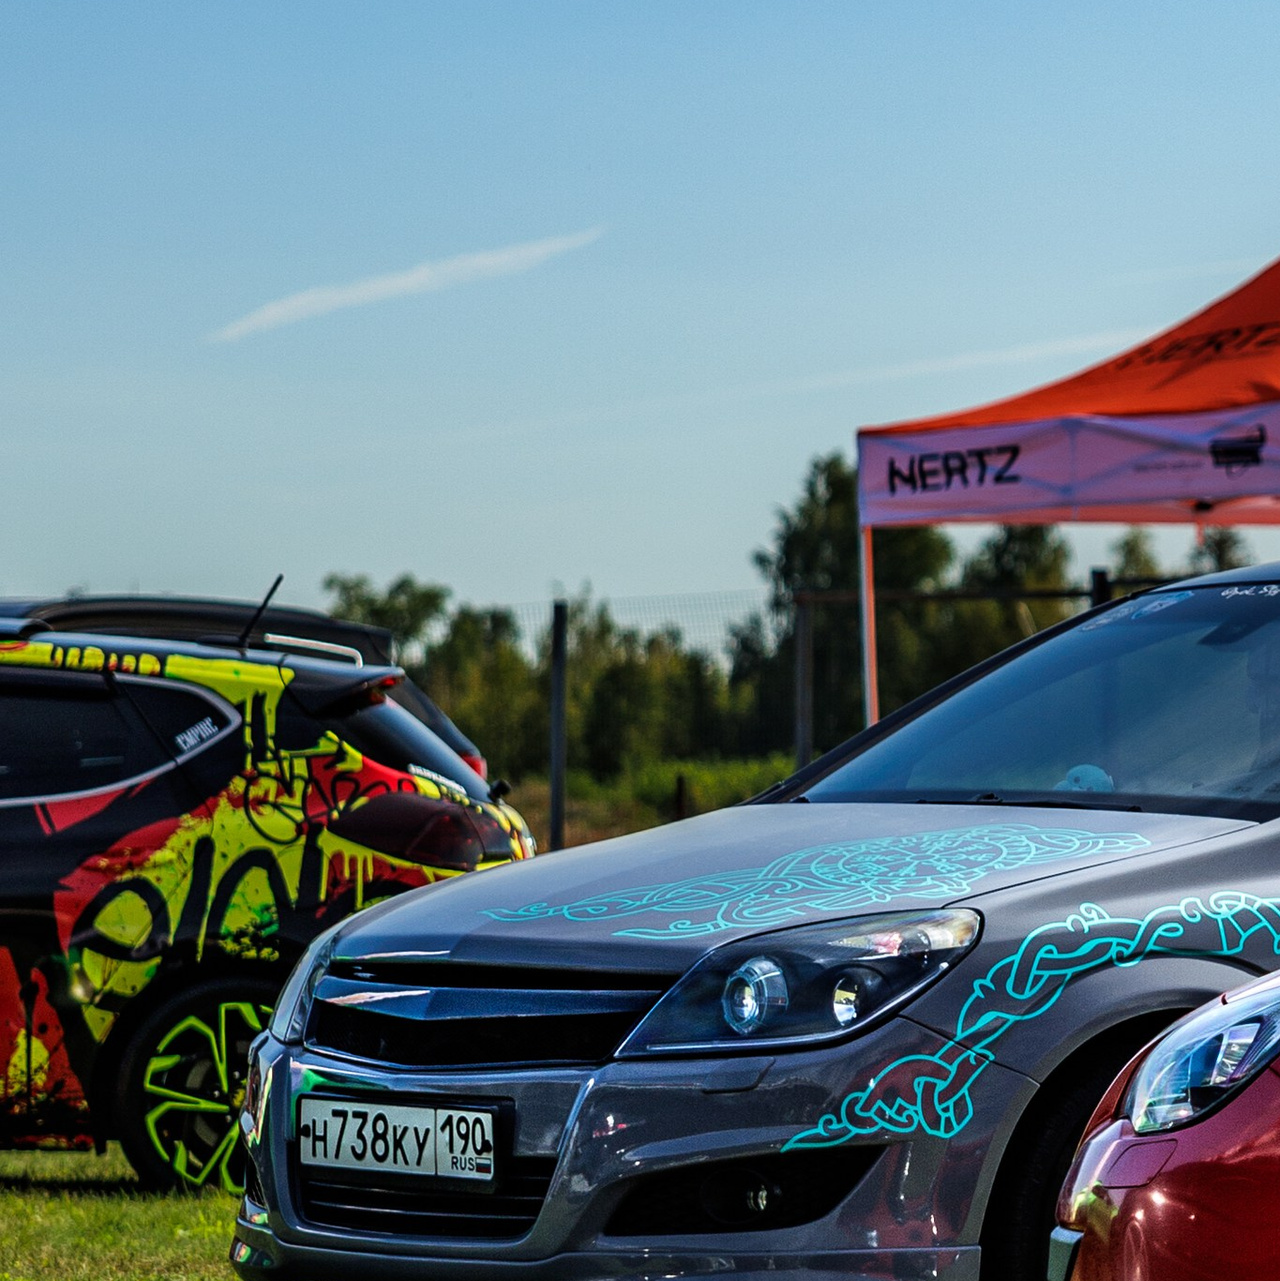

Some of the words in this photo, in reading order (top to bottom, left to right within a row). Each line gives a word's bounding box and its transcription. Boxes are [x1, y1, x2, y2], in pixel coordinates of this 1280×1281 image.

[886, 444, 1021, 497] HERTZ
[440, 1114, 486, 1156] 190
[451, 1156, 475, 1171] RUS
